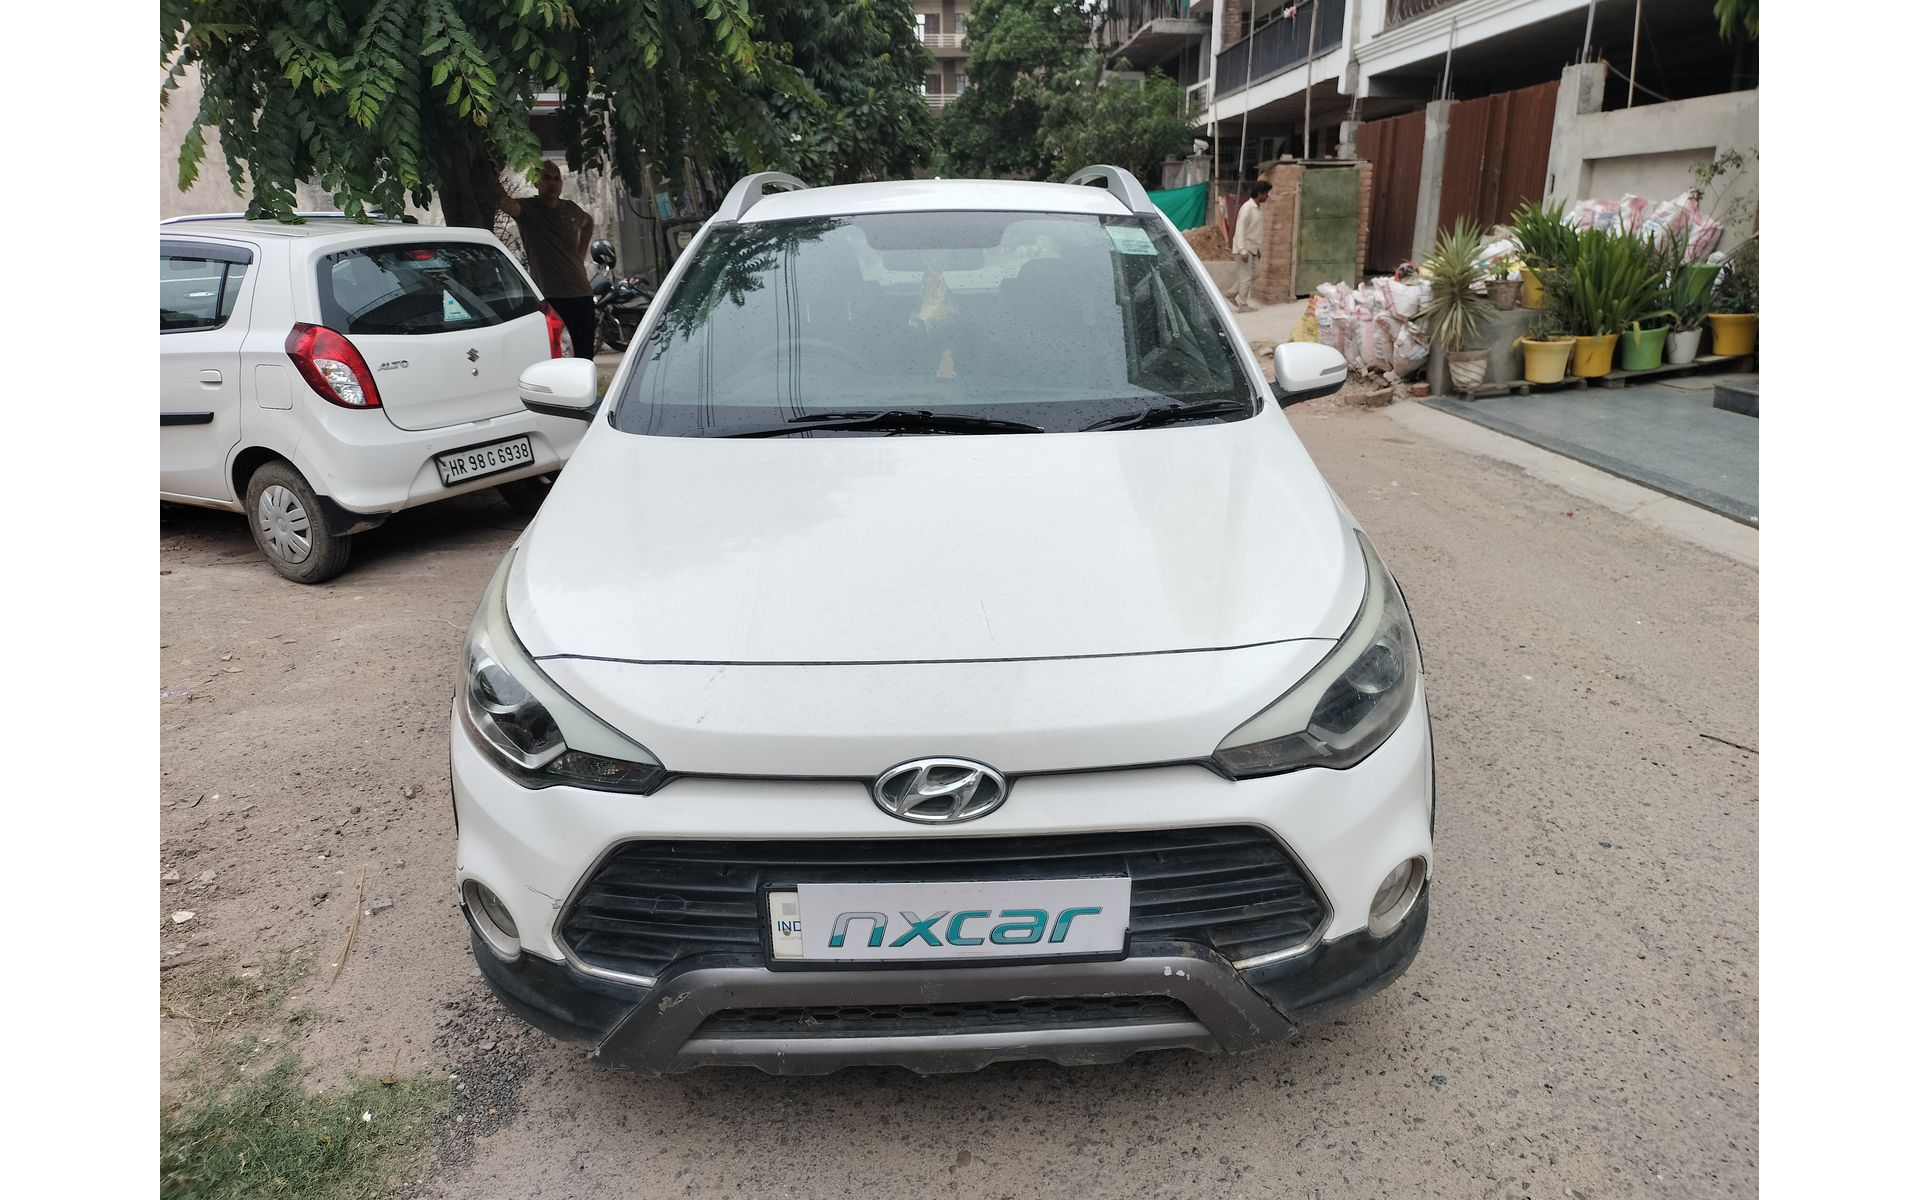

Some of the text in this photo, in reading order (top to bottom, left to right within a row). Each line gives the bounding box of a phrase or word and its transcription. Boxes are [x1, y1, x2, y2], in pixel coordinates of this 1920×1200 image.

[448, 443, 529, 476] HR 98 G 6938
[828, 907, 1103, 947] nxcar
